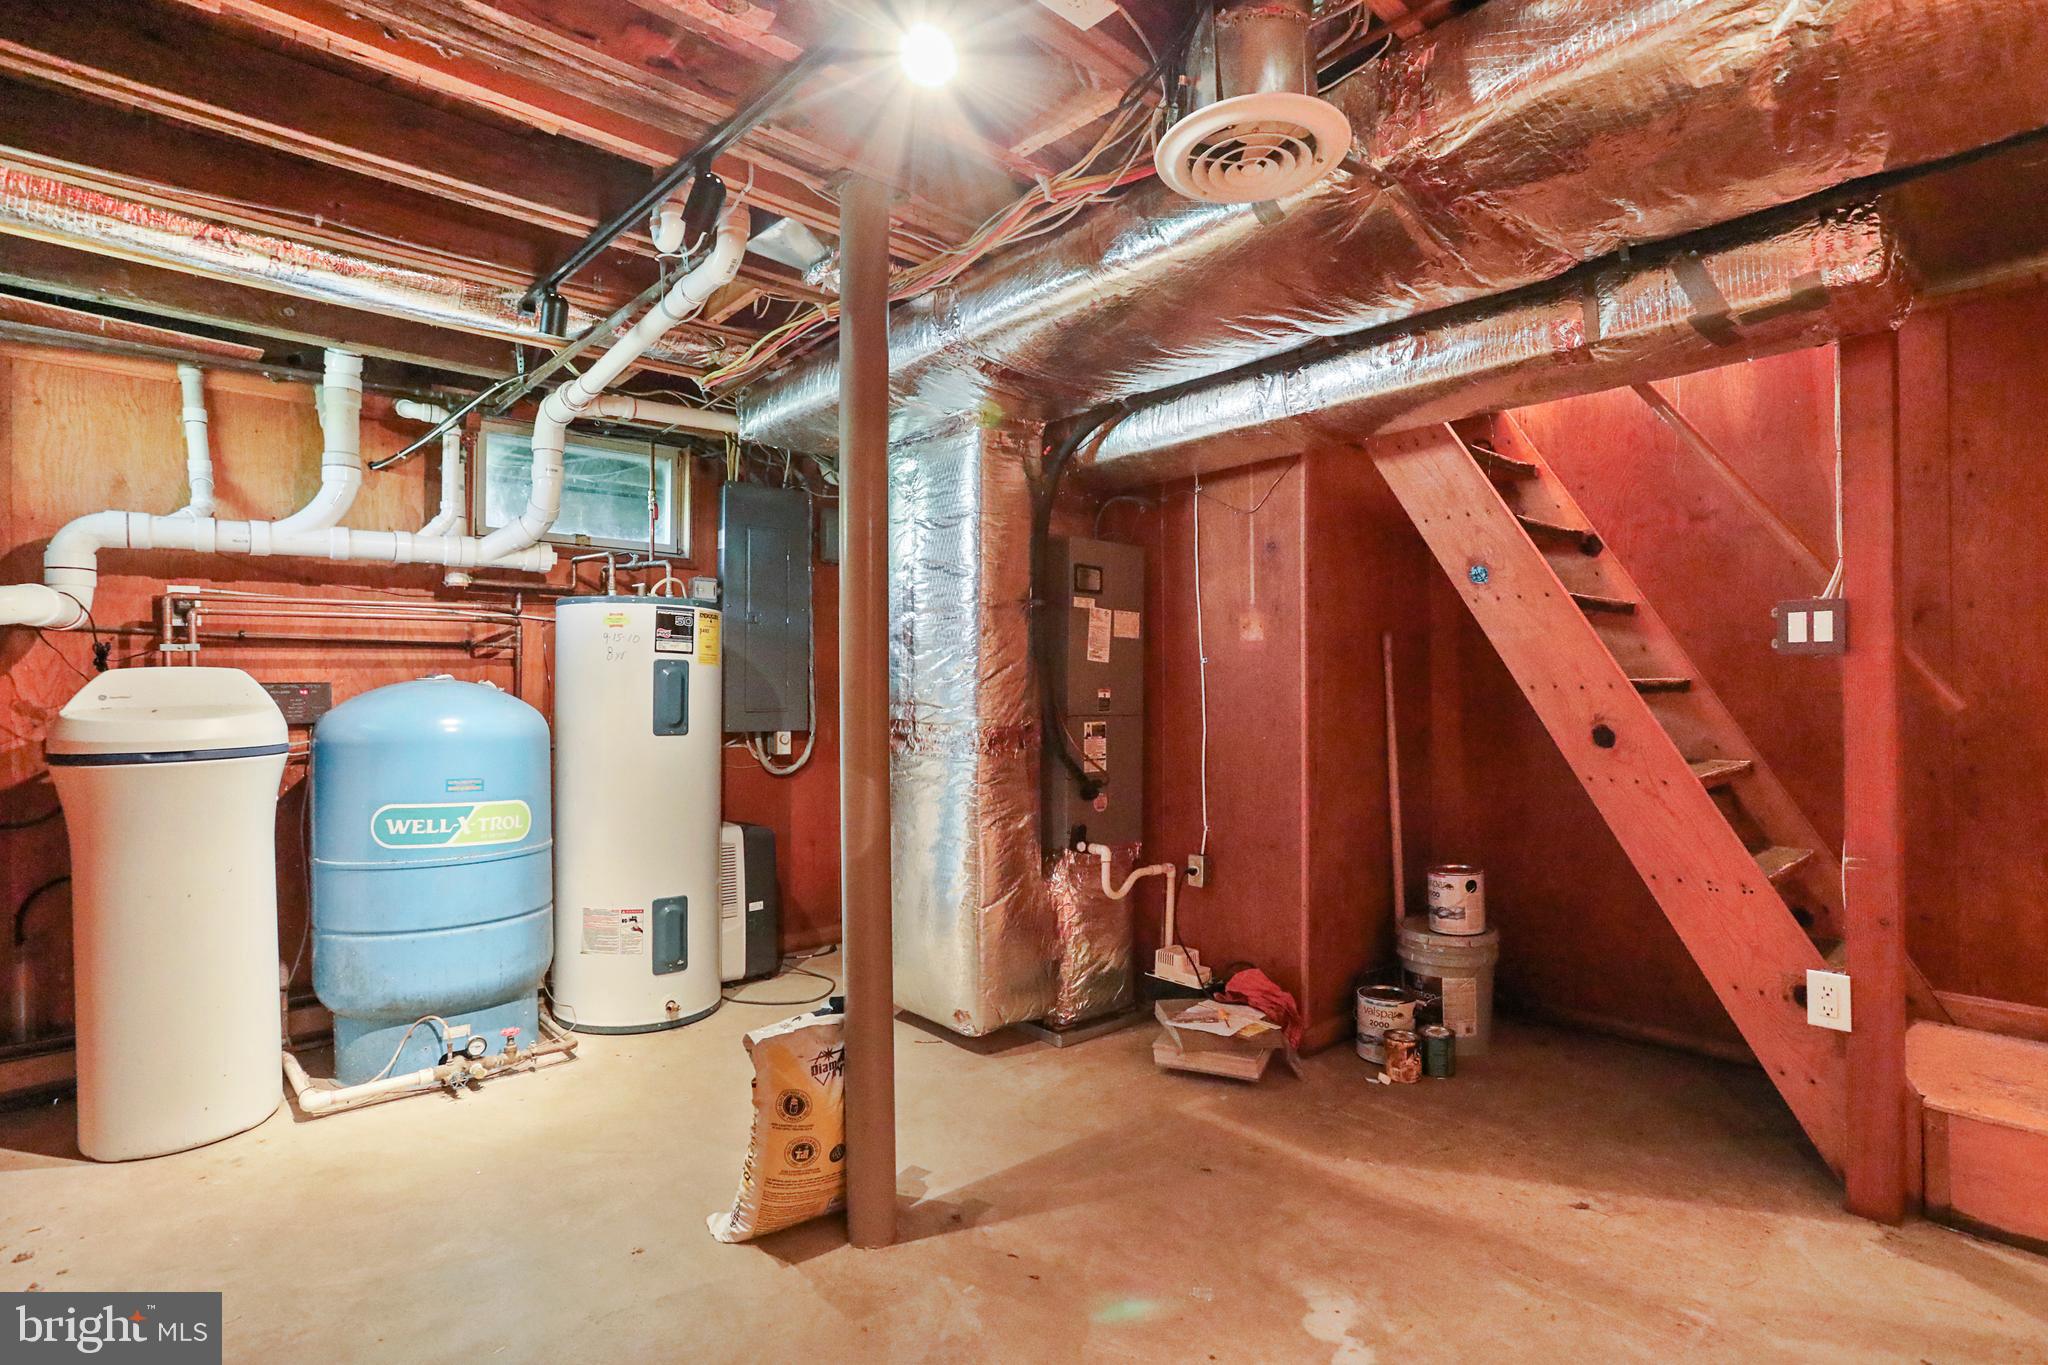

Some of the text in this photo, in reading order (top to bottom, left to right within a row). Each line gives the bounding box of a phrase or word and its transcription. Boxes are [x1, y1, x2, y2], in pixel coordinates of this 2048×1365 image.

[675, 615, 693, 627] 50
[385, 815, 524, 835] WELL-X-TROL
[1369, 1019, 1390, 1029] 2000
